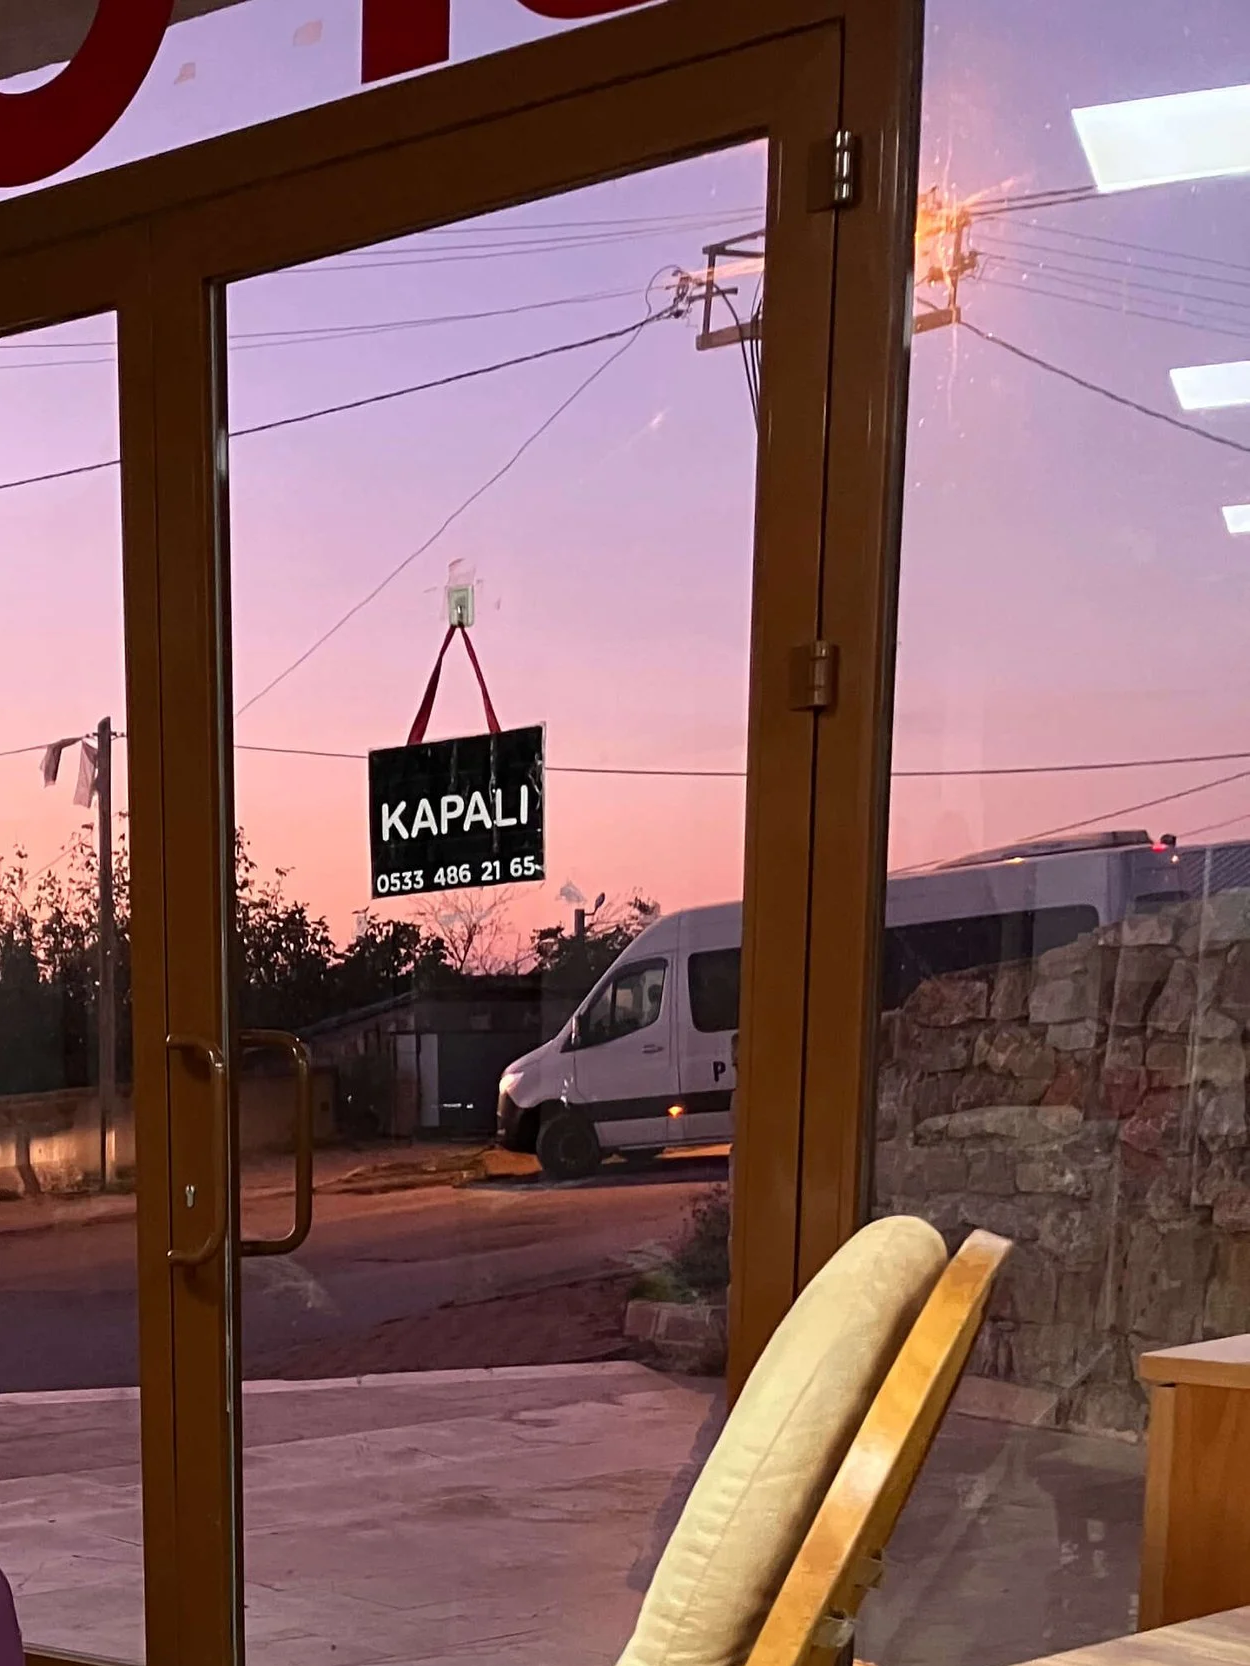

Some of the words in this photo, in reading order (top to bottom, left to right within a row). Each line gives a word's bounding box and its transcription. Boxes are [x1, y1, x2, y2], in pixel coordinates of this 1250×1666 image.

[381, 785, 528, 841] KAPALI
[377, 870, 424, 893] 0533
[434, 864, 471, 886] 486
[481, 861, 500, 881] 21
[510, 856, 535, 877] 65
